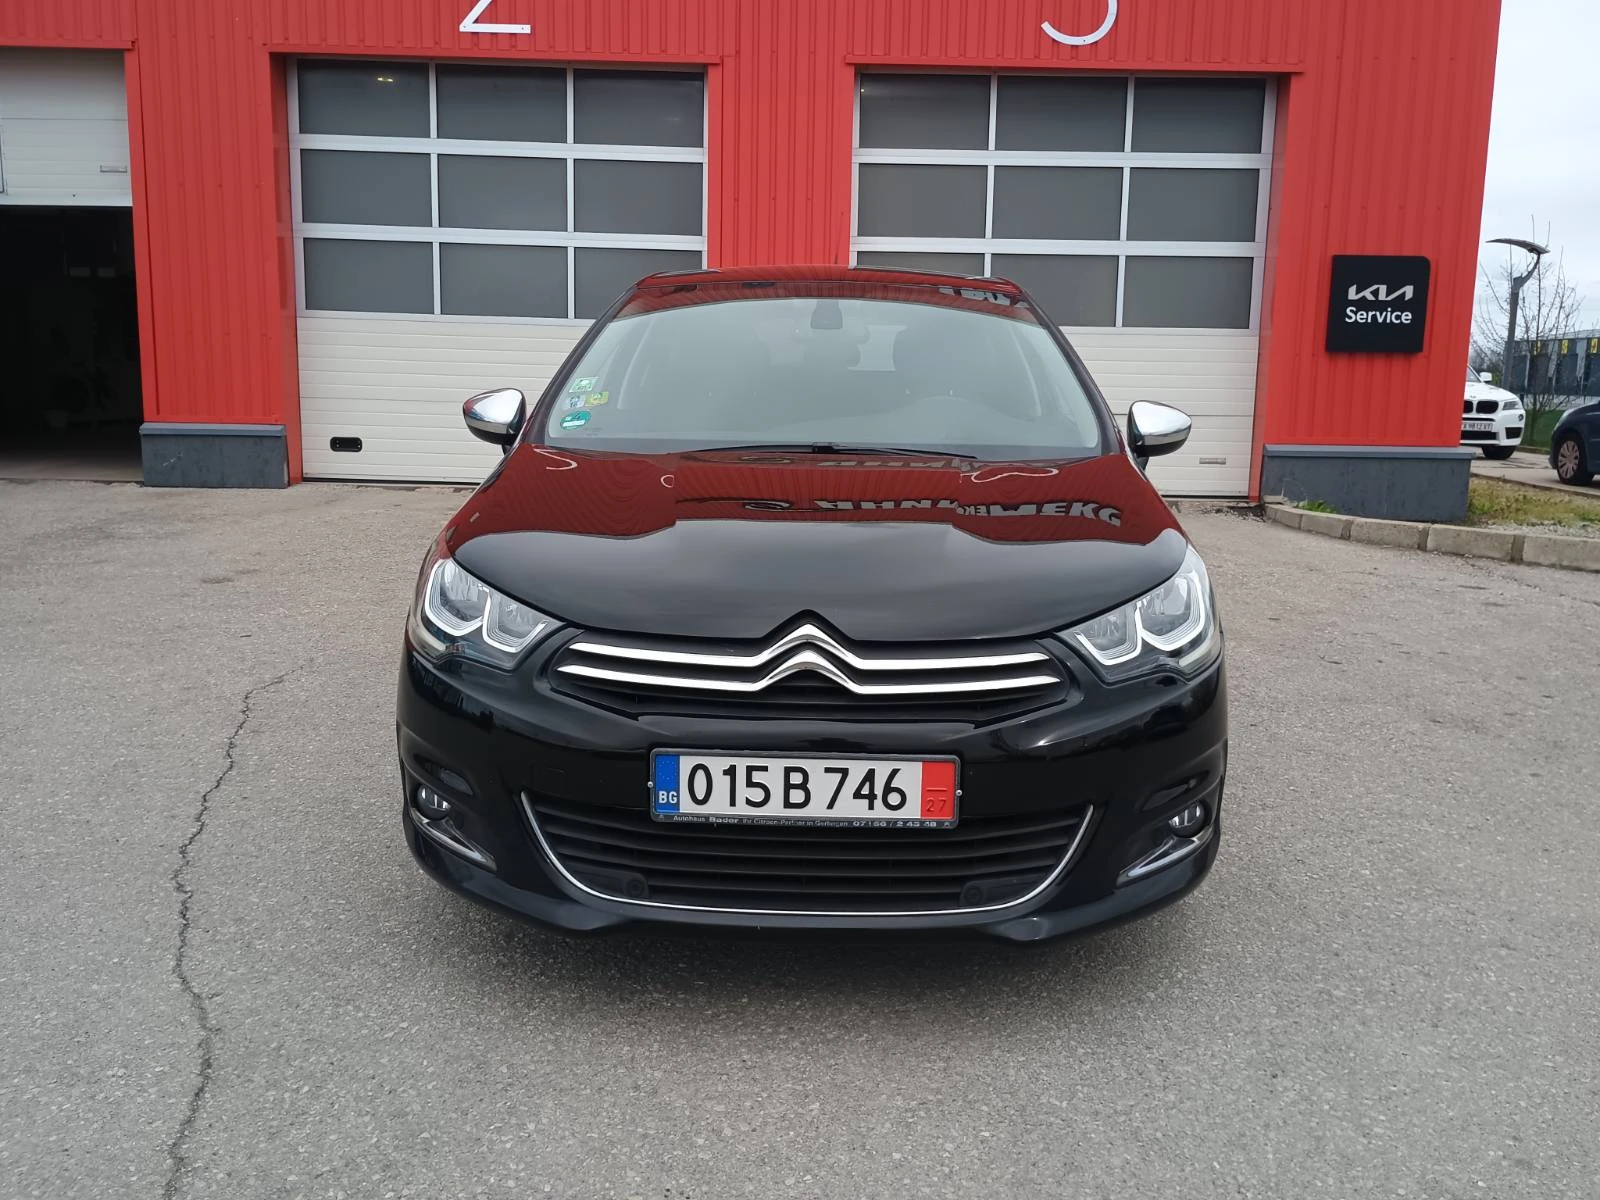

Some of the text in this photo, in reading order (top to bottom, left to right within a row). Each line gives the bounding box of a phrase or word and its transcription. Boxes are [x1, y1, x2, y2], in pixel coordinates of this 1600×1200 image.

[1347, 284, 1414, 301] KIA
[1345, 306, 1412, 324] Service
[658, 790, 678, 804] BG
[926, 797, 947, 813] 27
